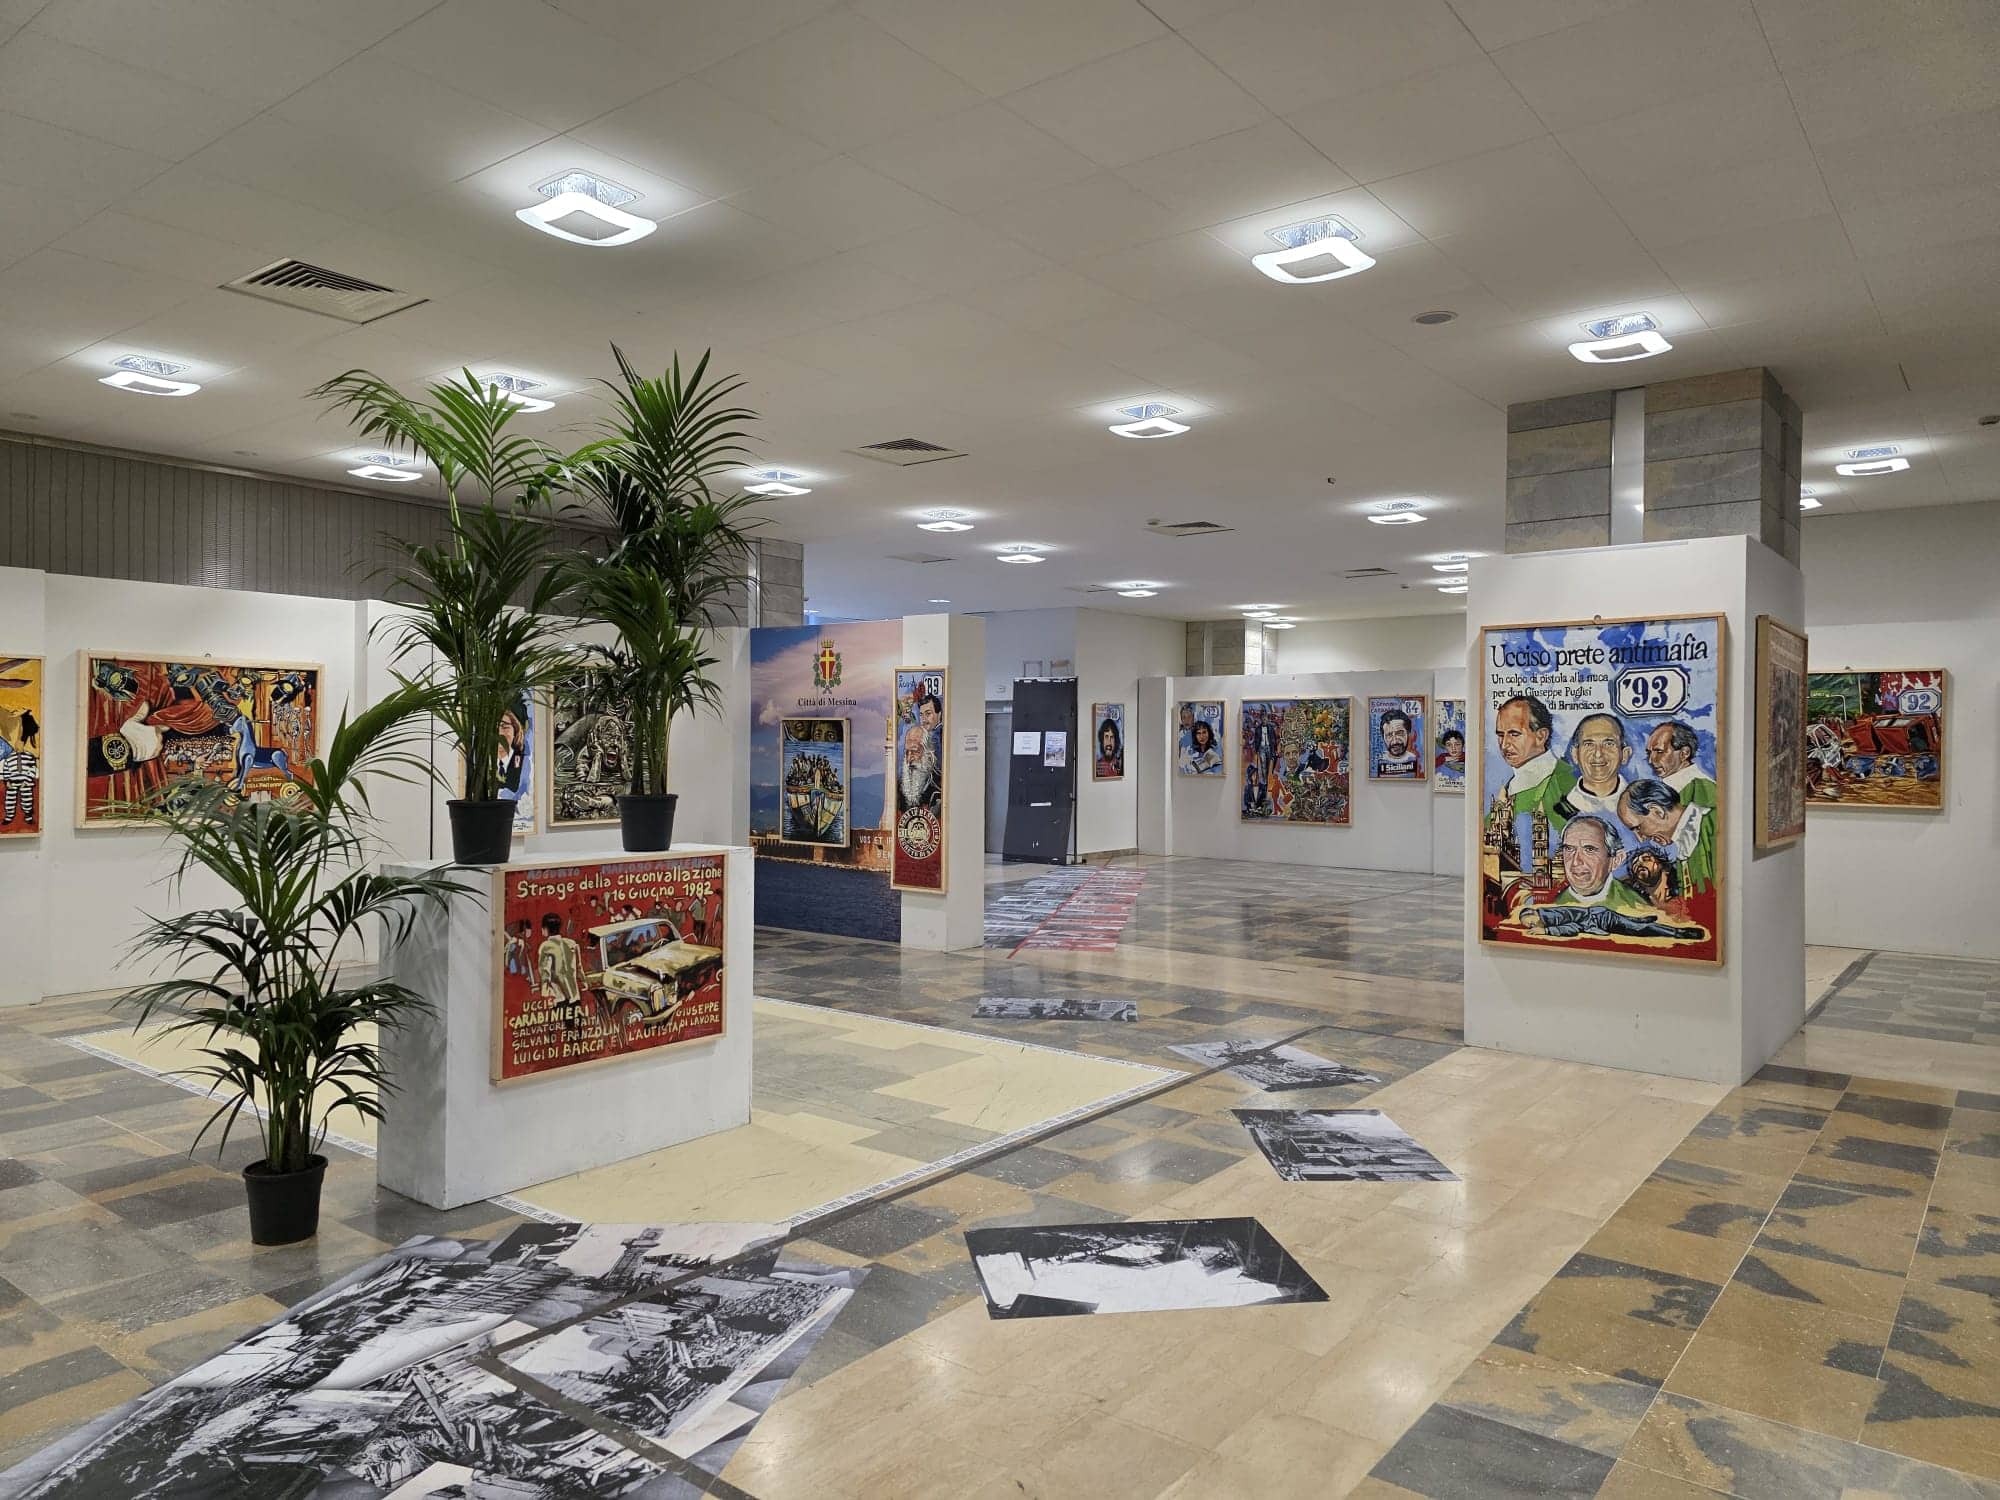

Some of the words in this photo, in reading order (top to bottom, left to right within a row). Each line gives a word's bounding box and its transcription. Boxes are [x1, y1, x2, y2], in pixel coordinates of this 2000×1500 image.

[1491, 644, 1550, 667] Ucciso
[1556, 645, 1604, 671] prete
[1608, 633, 1708, 664] antimafia
[1491, 674, 1504, 684] Un
[1506, 674, 1527, 686] colpo
[1530, 673, 1538, 682] di
[1540, 673, 1567, 685] pistola
[1570, 671, 1584, 682] alla
[1587, 673, 1608, 682] nuca
[1493, 690, 1505, 699] per
[1507, 687, 1522, 697] don
[1525, 686, 1562, 699] Giuseppe
[1565, 686, 1592, 699] Puglisi
[798, 697, 816, 706] Città
[818, 697, 826, 706] di
[827, 697, 857, 706] Messina
[1549, 700, 1556, 710] di
[1559, 701, 1605, 711] Brancaccio
[517, 880, 574, 900] Strage
[579, 872, 611, 890] della
[617, 864, 722, 886] circonvallazione
[612, 889, 625, 901] 16
[682, 881, 713, 897] 1982
[509, 1005, 590, 1029] CARABINIERI
[676, 1001, 720, 1017] GIUSEPPE
[512, 1021, 567, 1038] SALVATORE
[512, 1034, 557, 1050] SILVANO
[513, 1049, 545, 1065] LUIGI
[548, 1046, 559, 1058] DI
[563, 1040, 604, 1058] BARCA
